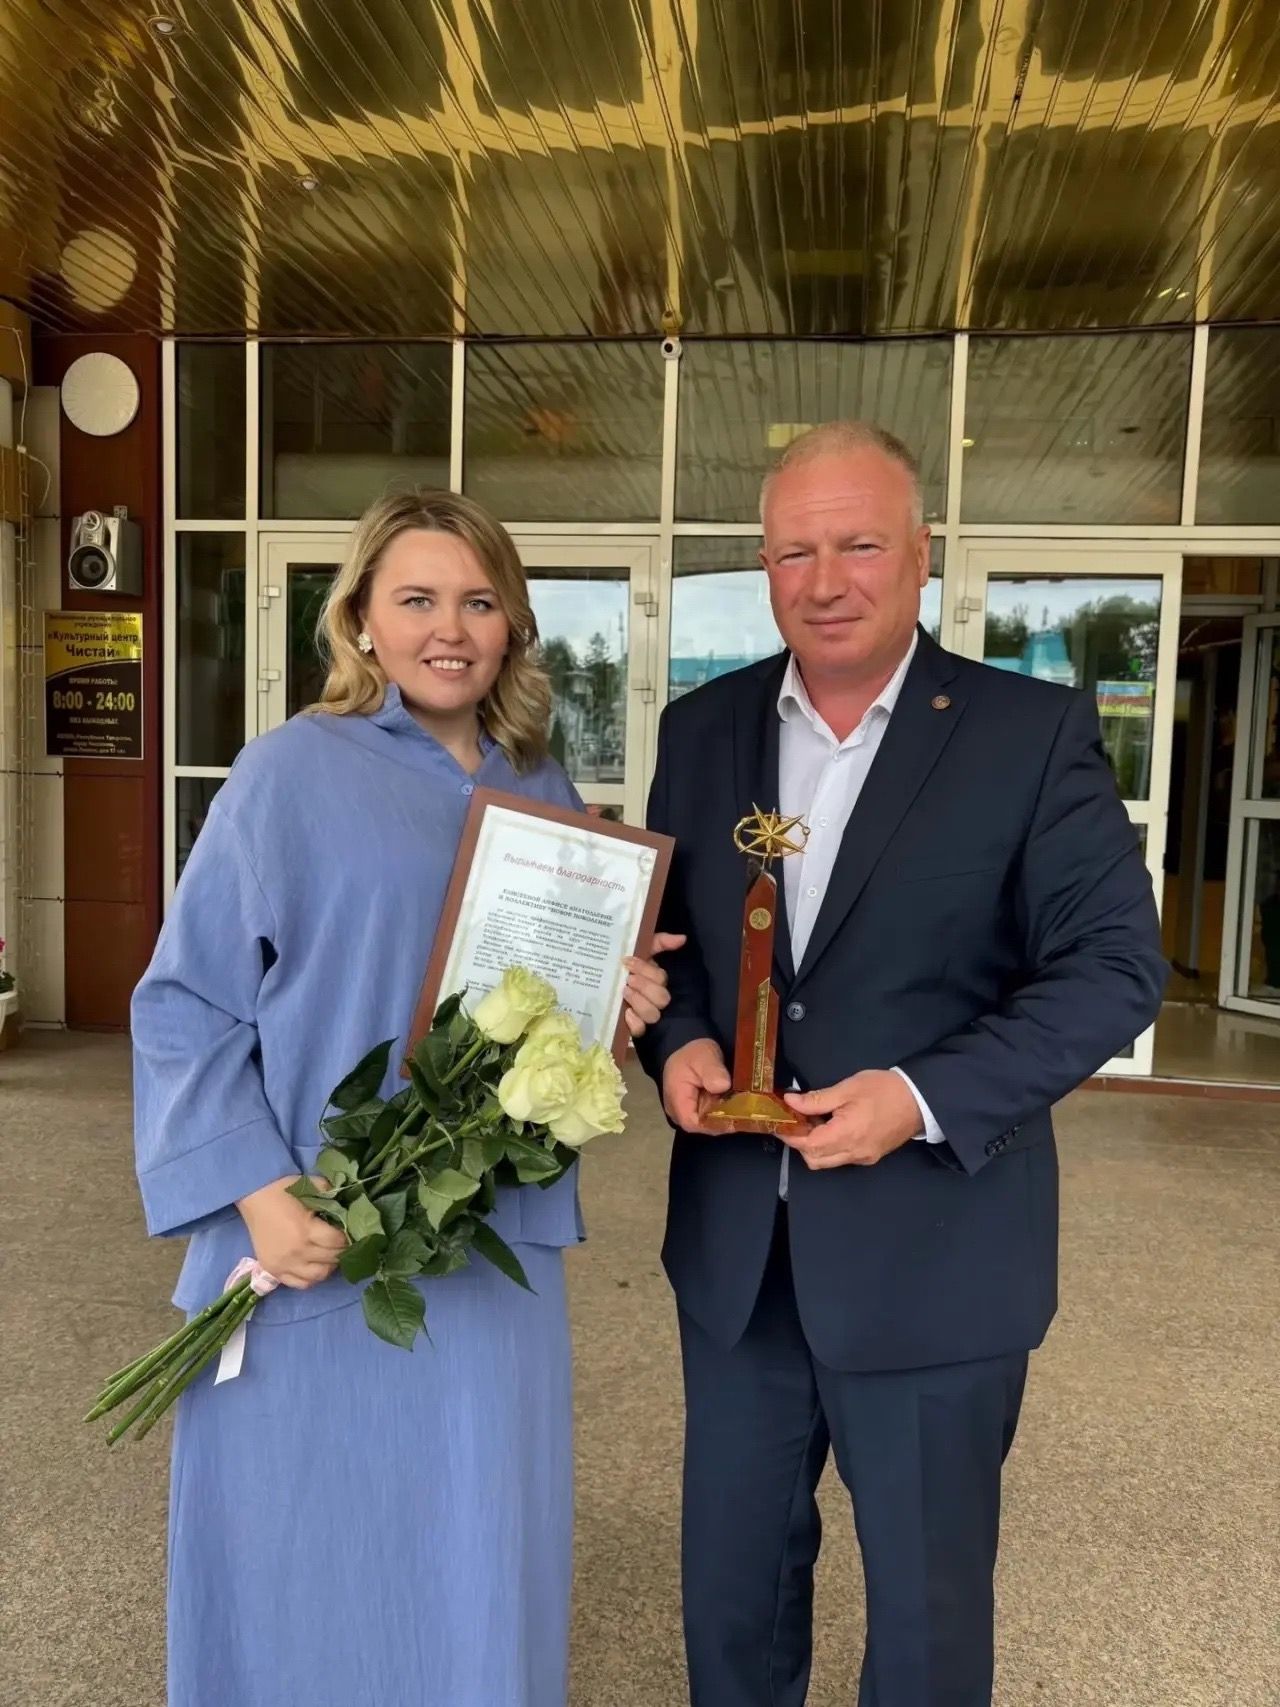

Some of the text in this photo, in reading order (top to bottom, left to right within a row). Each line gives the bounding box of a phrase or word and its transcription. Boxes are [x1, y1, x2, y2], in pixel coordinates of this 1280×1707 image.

[111, 632, 138, 643] центр
[53, 690, 83, 709] 8:00
[96, 692, 135, 711] 24:00
[556, 866, 626, 893] благодарность
